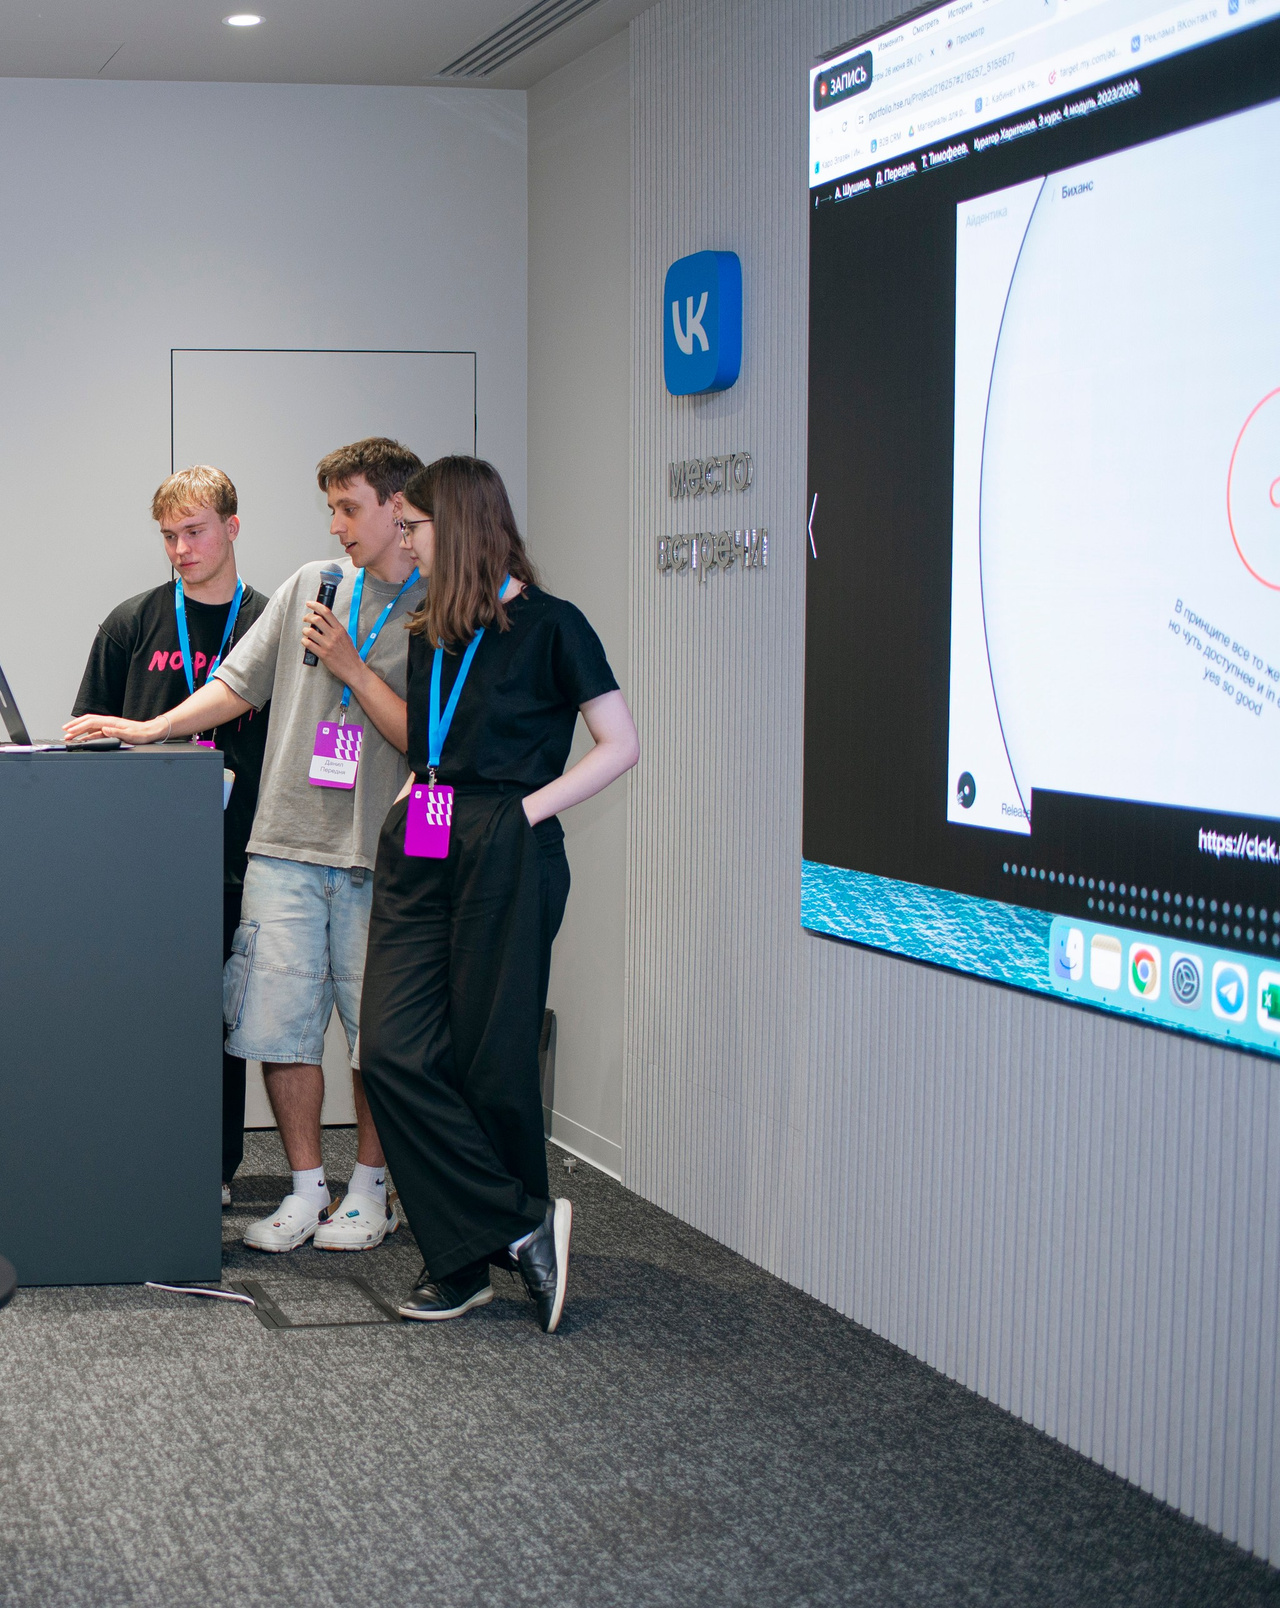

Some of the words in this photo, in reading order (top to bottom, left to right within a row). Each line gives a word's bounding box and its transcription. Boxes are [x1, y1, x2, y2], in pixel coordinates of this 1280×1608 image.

[877, 34, 905, 52] Изменить
[912, 18, 940, 36] Смотреть
[947, 1, 974, 19] История
[956, 26, 985, 45] Просмотр
[1144, 25, 1175, 44] Реклама
[1177, 9, 1218, 32] ВКонтакте
[830, 66, 867, 96] ЗАПИСЬ
[917, 115, 947, 131] Материалы
[974, 132, 1000, 152] Куратор
[1038, 113, 1044, 127] 3
[1063, 104, 1070, 118] 4
[1070, 97, 1097, 115] модуль
[1097, 78, 1141, 105] 2023/2024
[890, 132, 902, 145] CRM
[1062, 180, 1094, 199] Биханс
[965, 206, 1008, 228] Айдентика
[672, 291, 710, 355] VK
[668, 451, 754, 500] место
[656, 528, 768, 583] встречи
[148, 650, 184, 672] NO
[1168, 619, 1181, 635] но
[1182, 628, 1202, 651] чуть
[1202, 645, 1255, 688] доступнее
[1257, 681, 1264, 694] и
[1265, 685, 1276, 702] in
[1174, 598, 1183, 614] В
[1183, 608, 1231, 648] принципе
[1231, 642, 1250, 661] все
[1252, 654, 1263, 670] то
[1264, 664, 1280, 683] же
[1202, 666, 1221, 686] yes
[1222, 680, 1235, 696] so
[1235, 690, 1263, 716] good
